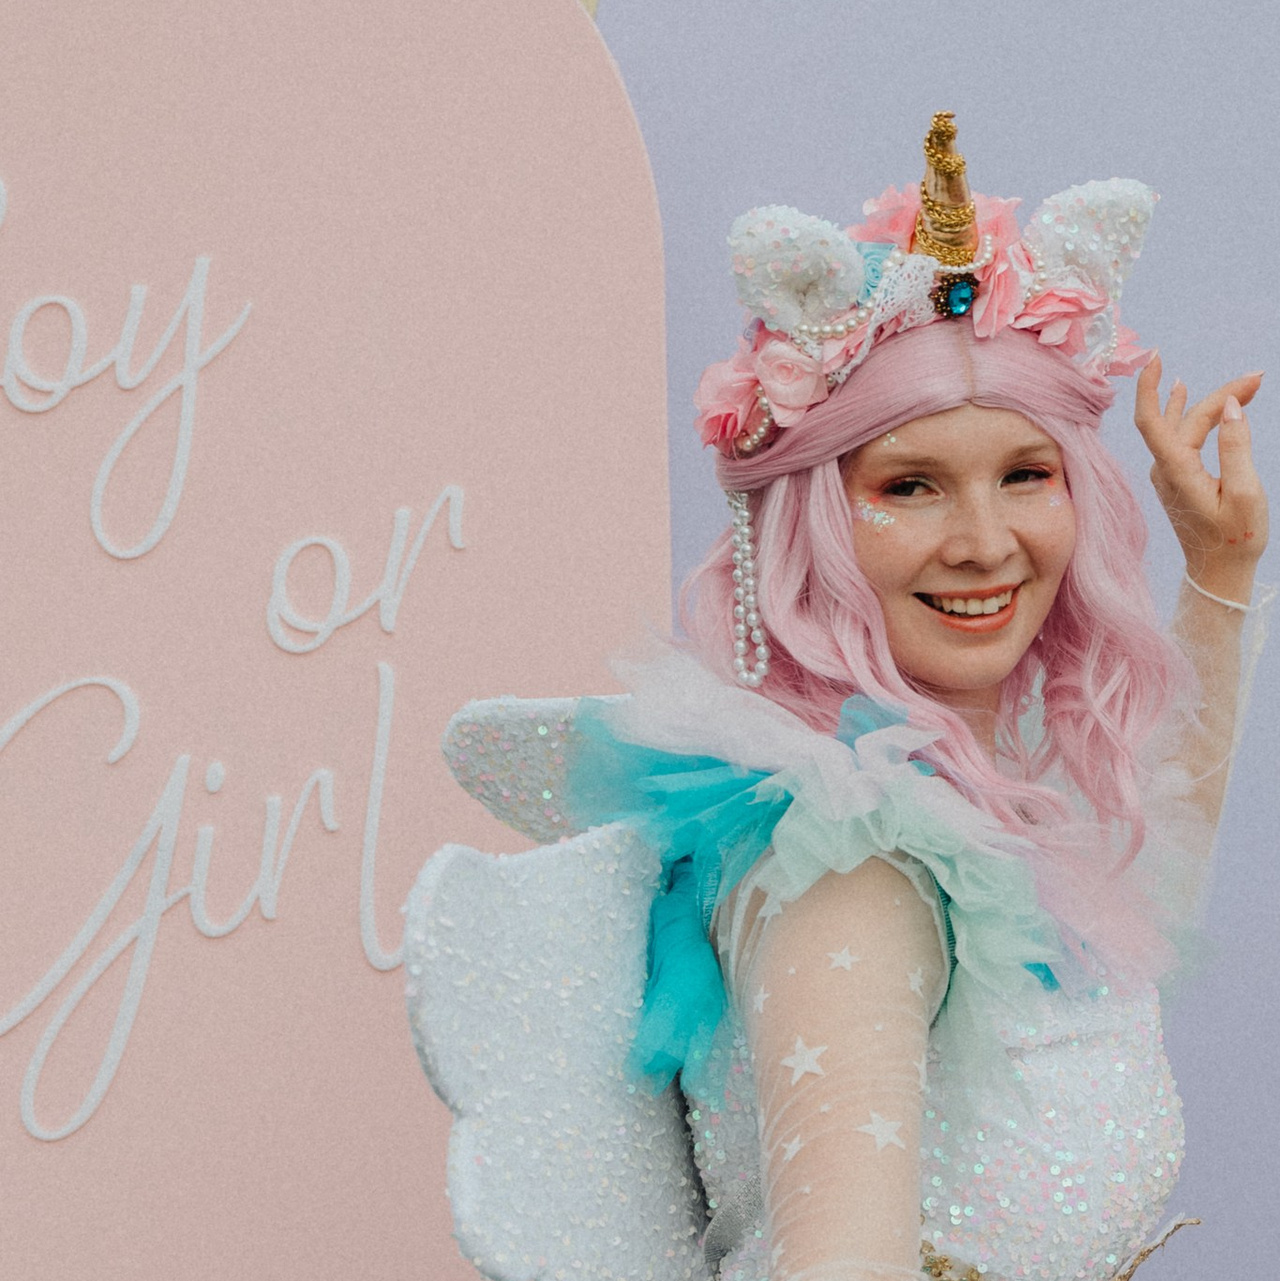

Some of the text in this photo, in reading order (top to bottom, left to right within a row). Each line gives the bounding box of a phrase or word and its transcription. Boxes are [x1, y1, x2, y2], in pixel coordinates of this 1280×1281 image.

[0, 176, 252, 561] oy
[266, 484, 467, 654] or
[0, 661, 406, 1143] Girl
